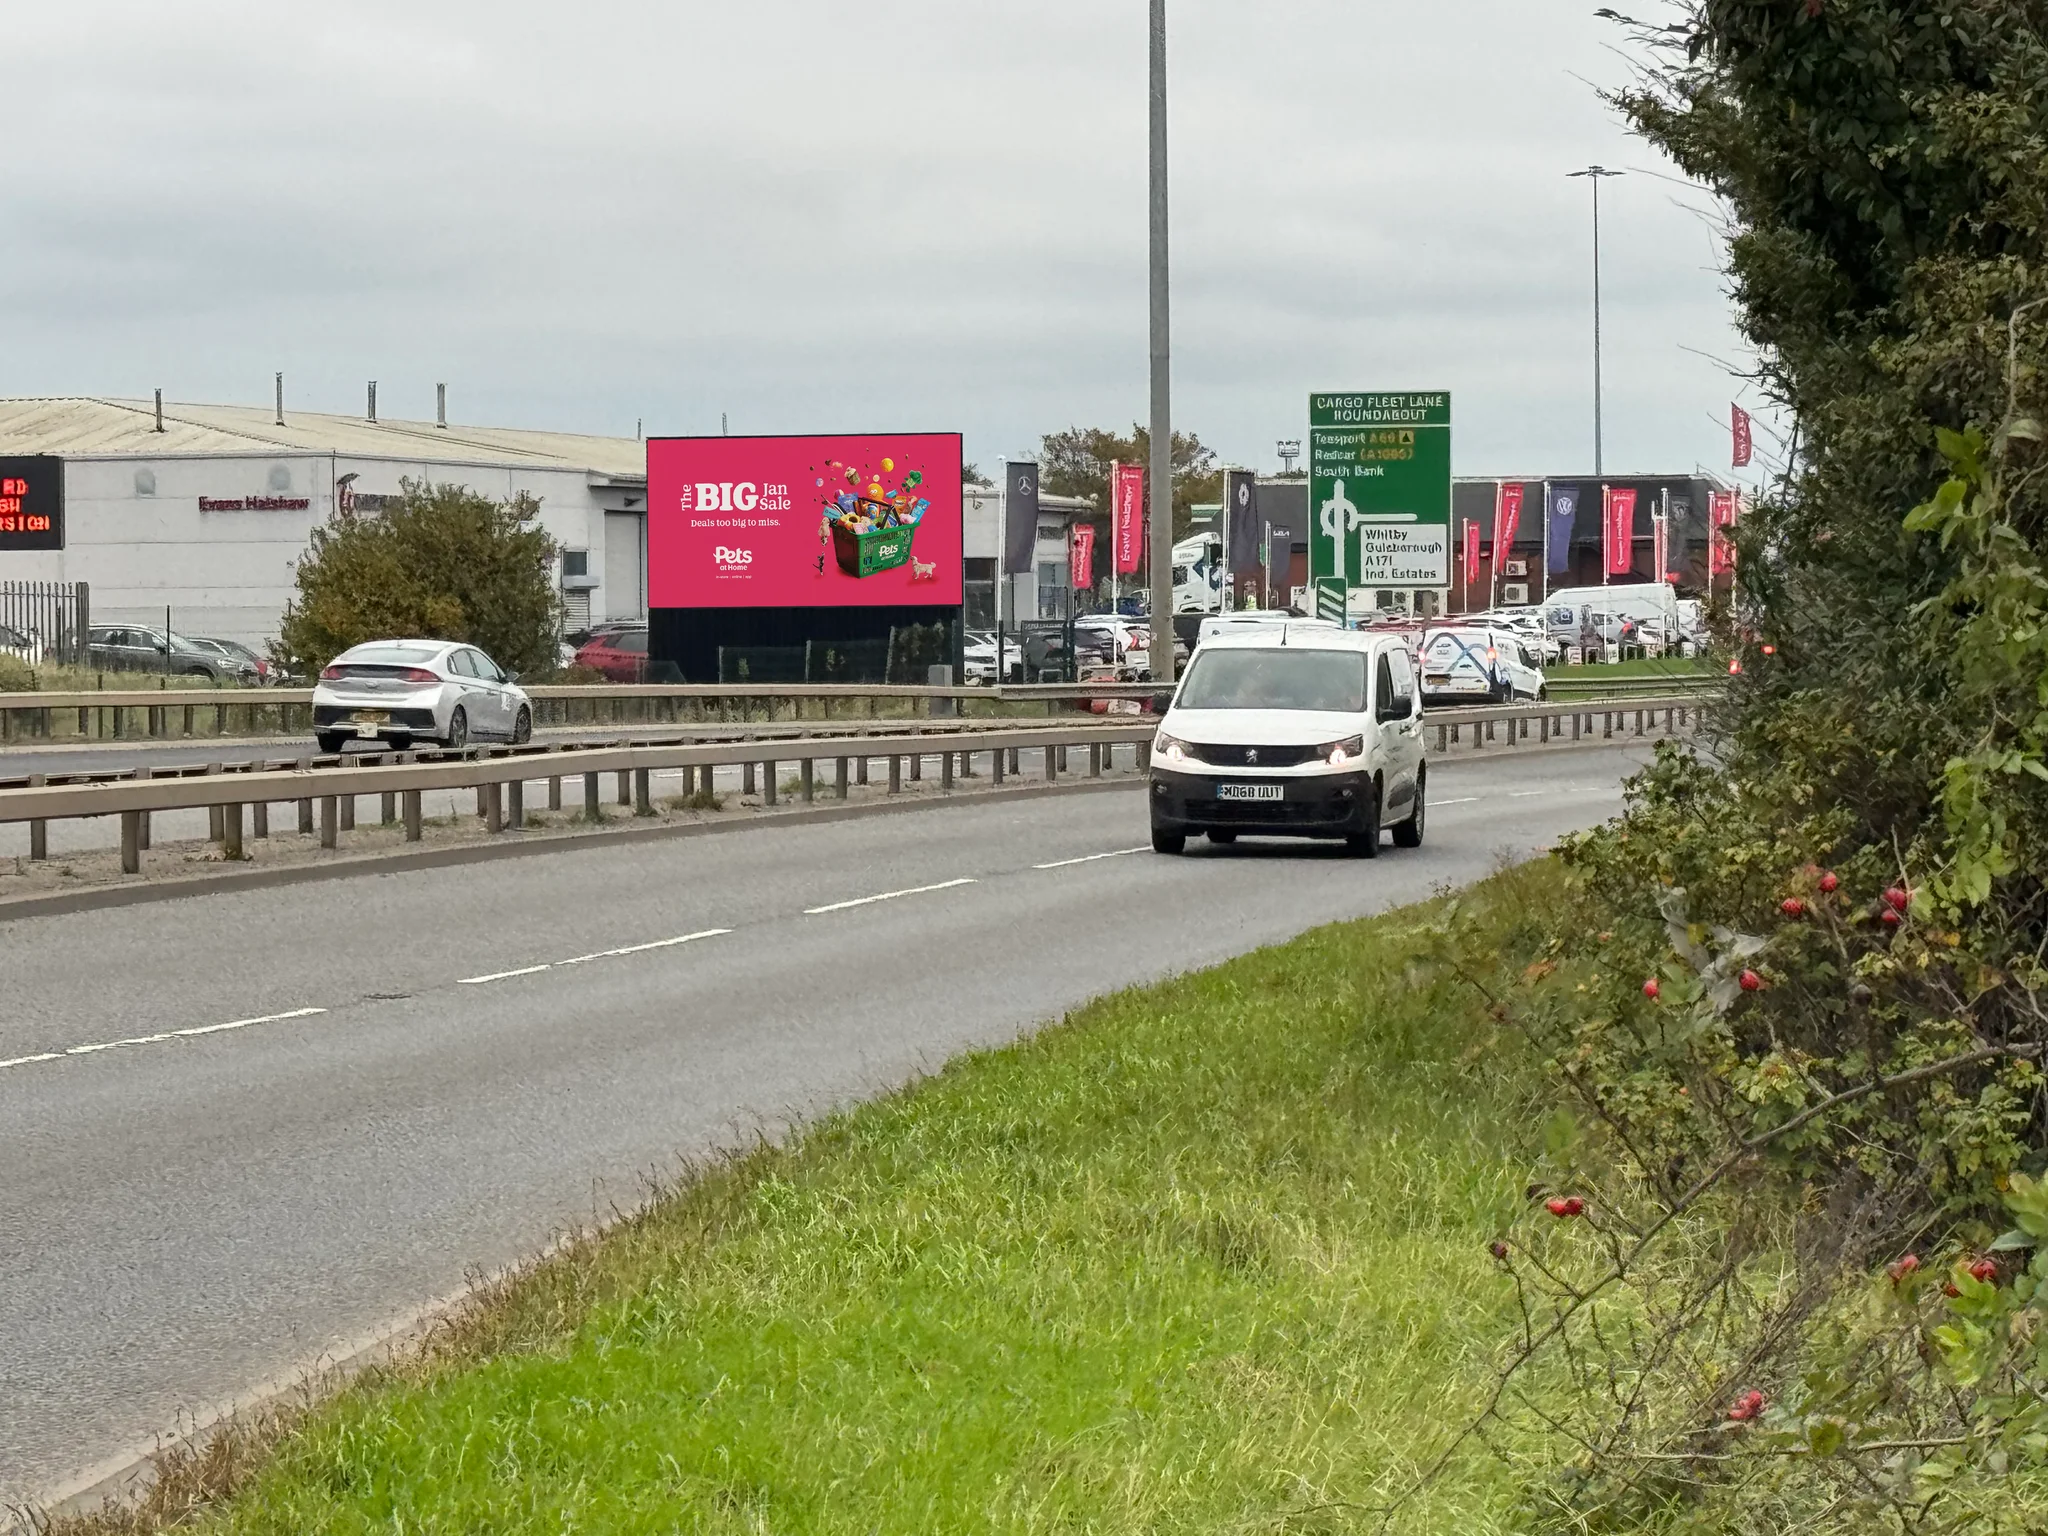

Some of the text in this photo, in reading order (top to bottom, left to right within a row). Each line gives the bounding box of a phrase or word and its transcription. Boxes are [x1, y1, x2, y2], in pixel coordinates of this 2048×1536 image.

[1317, 395, 1444, 409] CARGO FLEET LANE
[1334, 409, 1427, 421] ROUNDABOUT
[1315, 464, 1384, 477] South Bank
[694, 482, 759, 511] BIG
[762, 483, 788, 497] Jan
[681, 484, 692, 511] The
[759, 496, 791, 510] Sale
[691, 518, 781, 528] Deals too big to miss.
[1365, 529, 1408, 541] Whitby
[713, 546, 753, 564] Pets
[879, 544, 899, 557] Pets
[1365, 568, 1437, 580] Ind. Estates
